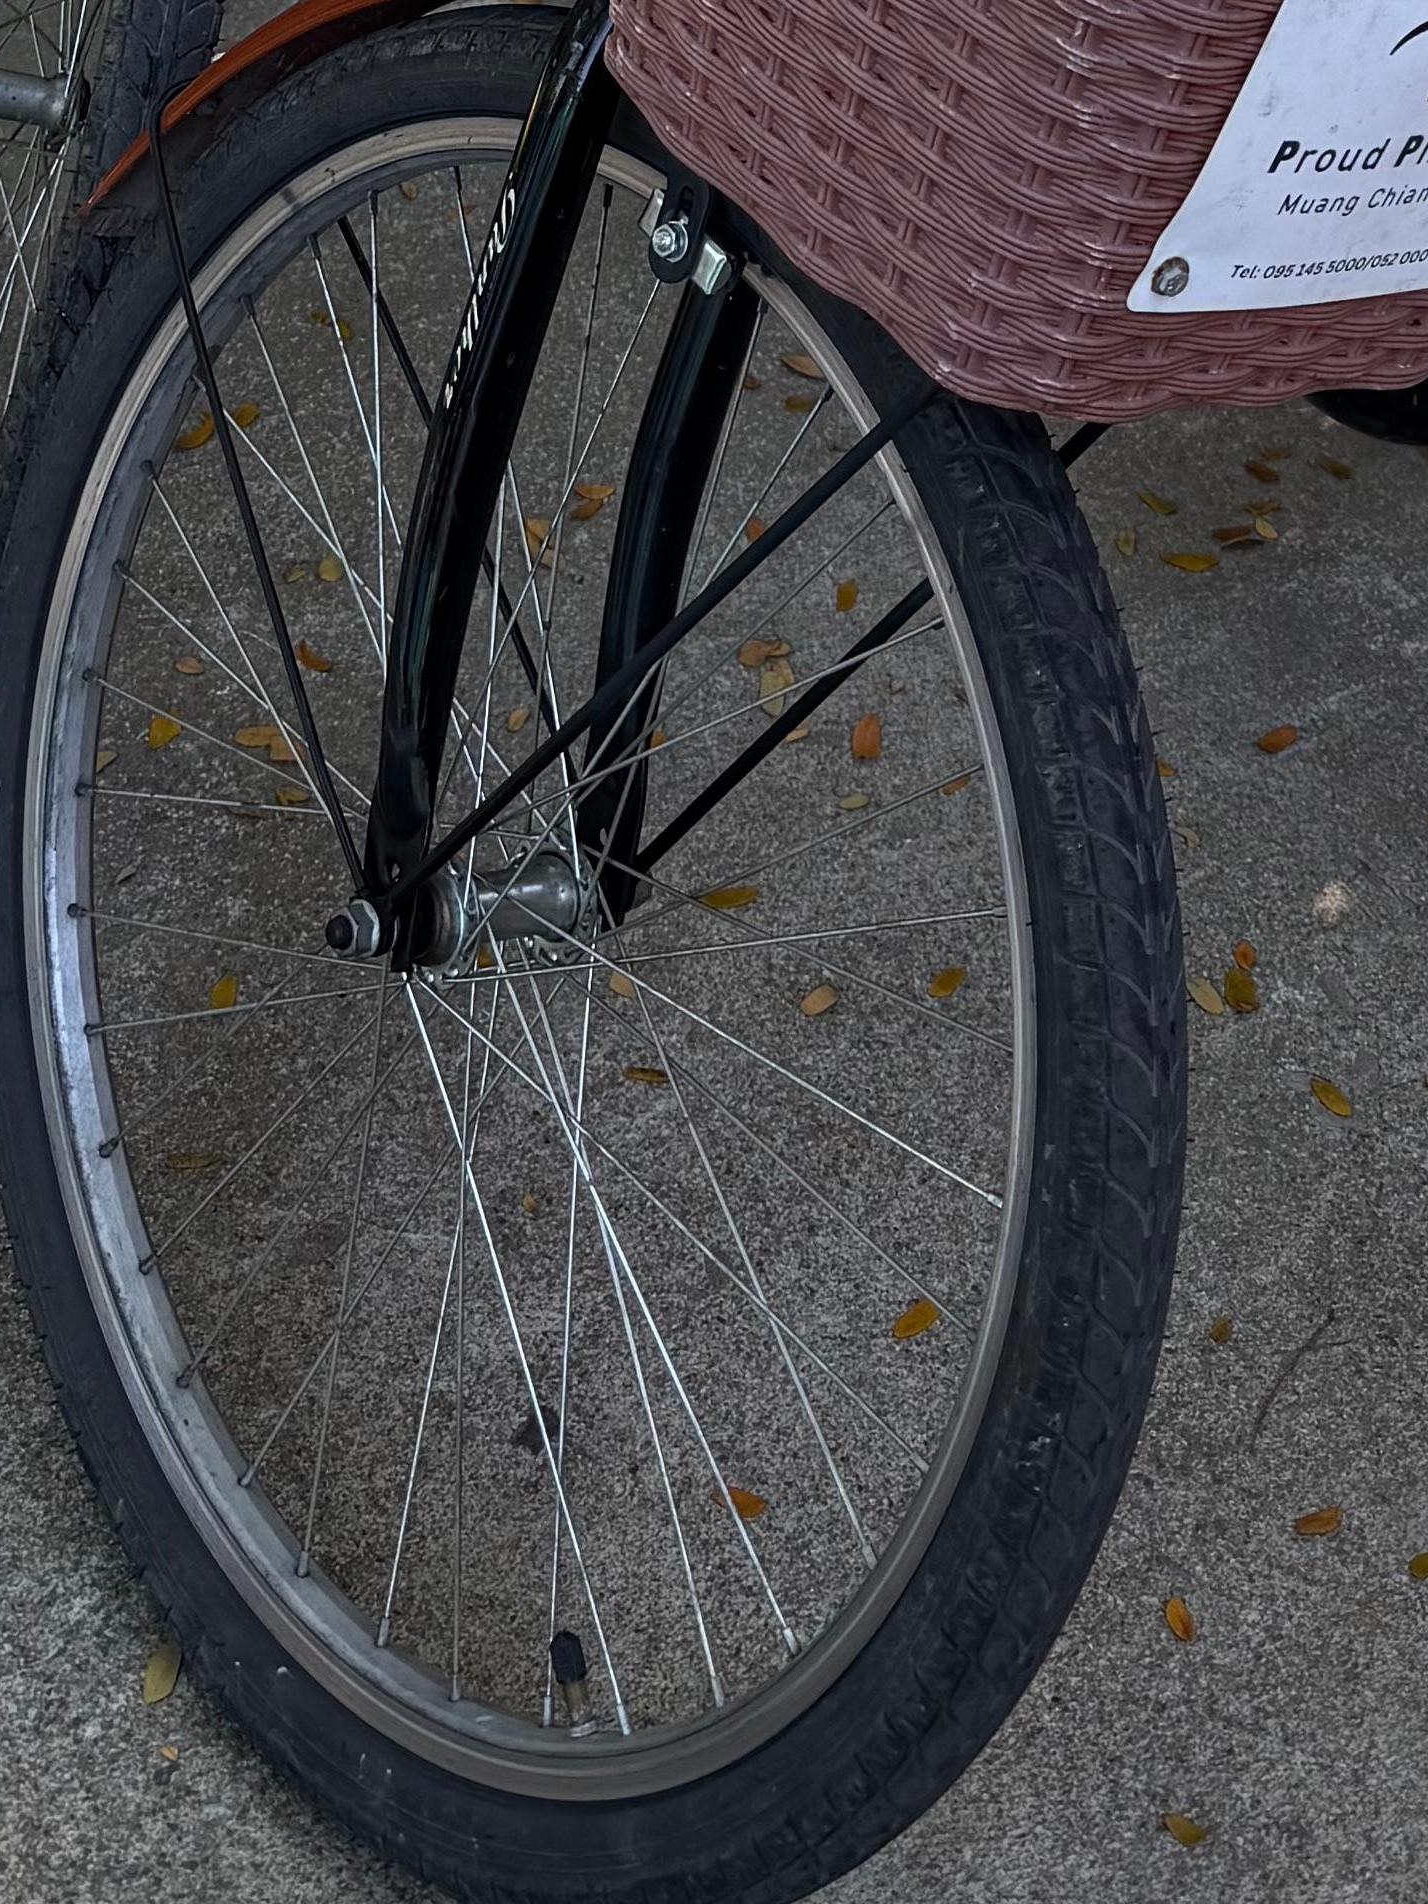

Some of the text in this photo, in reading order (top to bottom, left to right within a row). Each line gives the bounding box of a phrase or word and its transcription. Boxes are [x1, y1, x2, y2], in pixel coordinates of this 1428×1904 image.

[1267, 138, 1392, 174] Proud
[1276, 194, 1360, 217] Muang
[1230, 264, 1261, 279] Tel:
[1263, 264, 1296, 279] 095
[1295, 261, 1324, 277] 145
[1325, 252, 1400, 275] 5000/052
